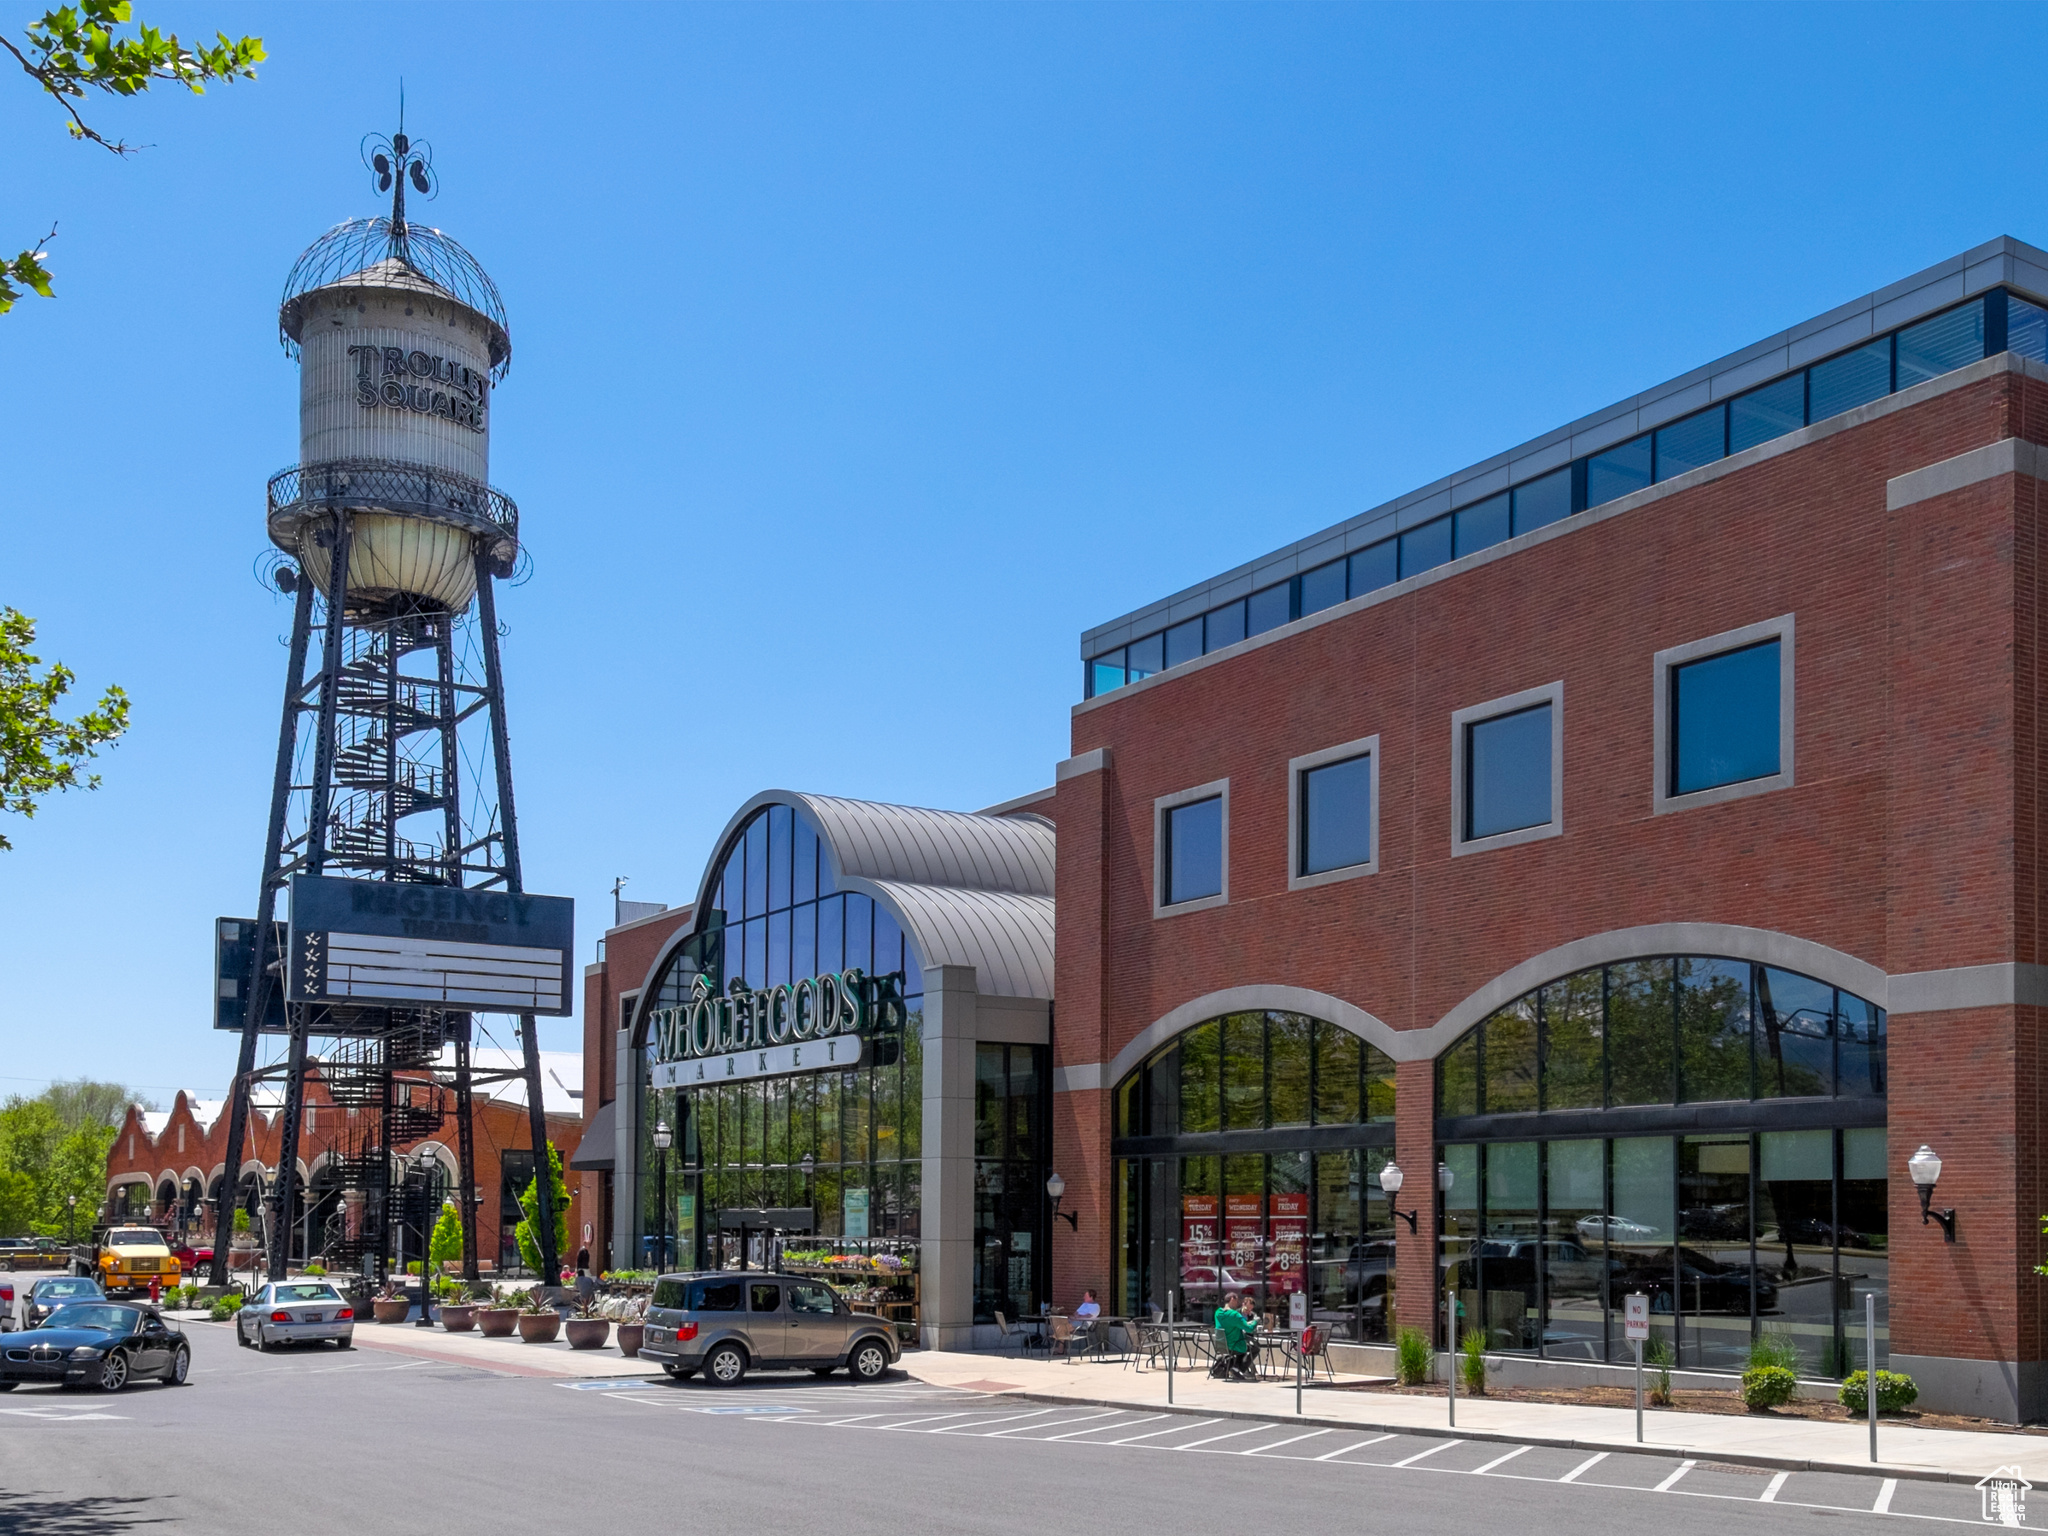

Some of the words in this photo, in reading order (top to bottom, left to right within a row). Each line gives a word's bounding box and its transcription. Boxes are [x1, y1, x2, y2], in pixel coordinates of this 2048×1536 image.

[348, 344, 491, 409] TROLLEY
[356, 379, 485, 434] SQUARE
[351, 884, 533, 926] REGENCY
[650, 990, 750, 1064] WHOLE
[752, 967, 863, 1047] FOODS
[666, 1040, 837, 1084] MARKET
[1626, 1320, 1648, 1328] PARKING
[1632, 1306, 1642, 1314] NO
